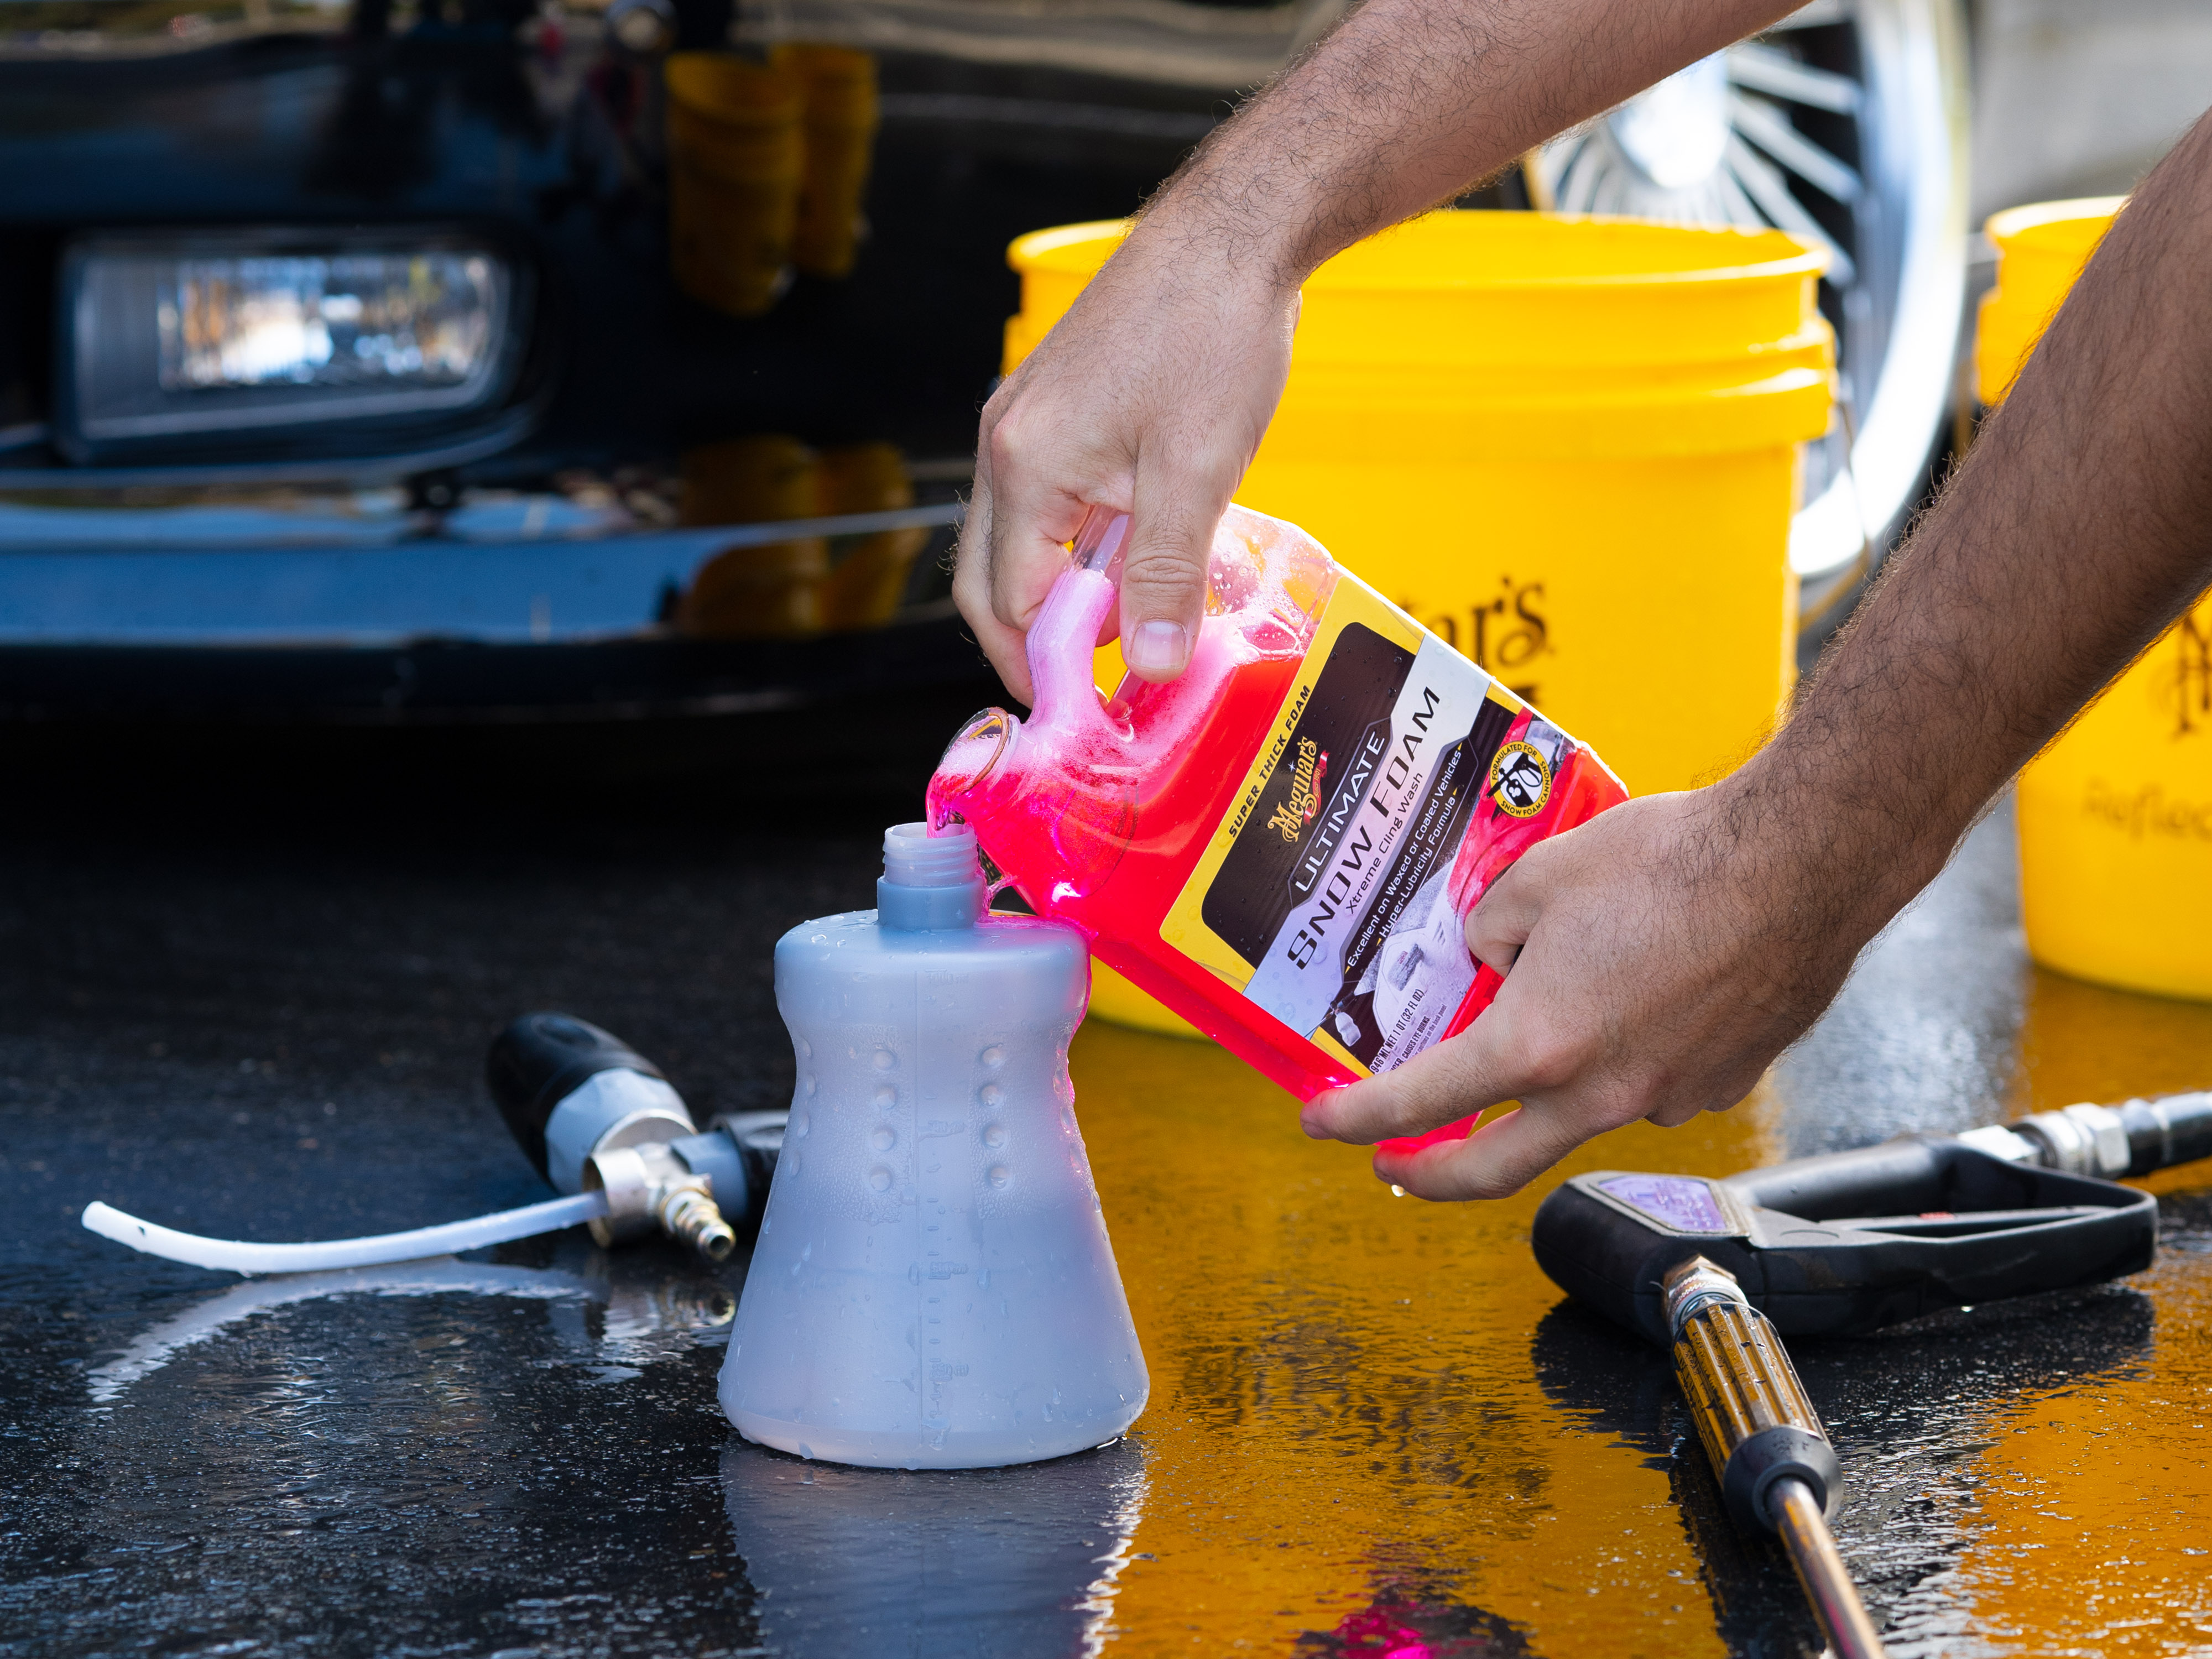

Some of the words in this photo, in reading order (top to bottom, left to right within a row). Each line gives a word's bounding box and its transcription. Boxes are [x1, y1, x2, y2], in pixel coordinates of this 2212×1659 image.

[1229, 785, 1260, 838] SUPER
[1259, 733, 1286, 780] THICK
[1285, 685, 1311, 731] FOAM
[1492, 744, 1522, 780] FORMULATED
[1524, 745, 1537, 757] FOR
[1267, 736, 1317, 842] Meguiar's
[1501, 800, 1521, 816] SNOW
[1523, 804, 1542, 816] FOAM
[1540, 761, 1550, 803] CANNONS
[1287, 825, 1373, 970] SNOW
[1370, 687, 1441, 818] FOAM
[1296, 731, 1385, 893] ULTIMATE
[1345, 857, 1381, 914] Xtreme
[1379, 817, 1403, 854] Cling
[1397, 773, 1423, 813] Wash
[1348, 915, 1380, 967] Excellent
[1378, 898, 1390, 914] on
[1385, 855, 1411, 895] Waxed
[1410, 841, 1418, 854] or
[1415, 799, 1439, 840] Coated
[1434, 750, 1461, 796] Vehicles
[1379, 847, 1433, 938] Hyper-Lubricity
[1428, 796, 1455, 845] Formula
[1407, 1000, 1418, 1010] FL
[1412, 989, 1425, 1002] OZ)
[1396, 1020, 1406, 1031] QT
[1400, 1008, 1413, 1022] (32
[1379, 1046, 1391, 1060] ML
[1385, 1034, 1398, 1049] NET
[1402, 1039, 1416, 1059] CAUSES
[1412, 1030, 1422, 1042] EYE
[1370, 1057, 1384, 1073] 946
